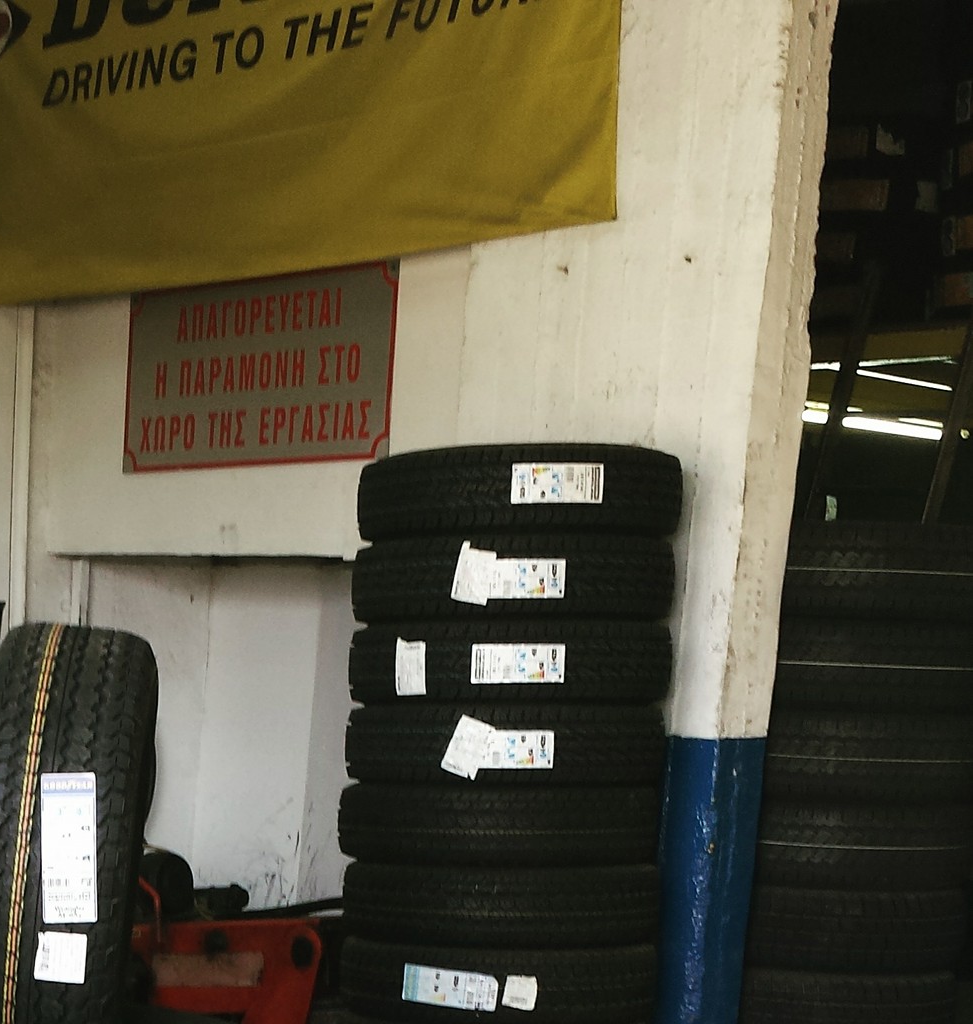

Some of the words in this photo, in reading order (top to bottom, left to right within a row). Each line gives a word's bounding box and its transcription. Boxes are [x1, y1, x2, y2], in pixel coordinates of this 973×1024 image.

[42, 38, 198, 108] DRIVING
[212, 25, 265, 75] TO
[283, 2, 374, 60] THE
[177, 287, 342, 343] ΑΠΑΓΟΡΕΥΕΤΑΙ
[154, 360, 168, 399] Η
[179, 347, 306, 397] ΠΑΡΑΜΟΝΗ
[317, 343, 362, 386] ΣΤΟ
[139, 412, 196, 454] ΧΩΡΟ
[207, 407, 247, 449] ΤΗΣ
[258, 399, 372, 446] ΕΡΓΑΣΙΑΣ
